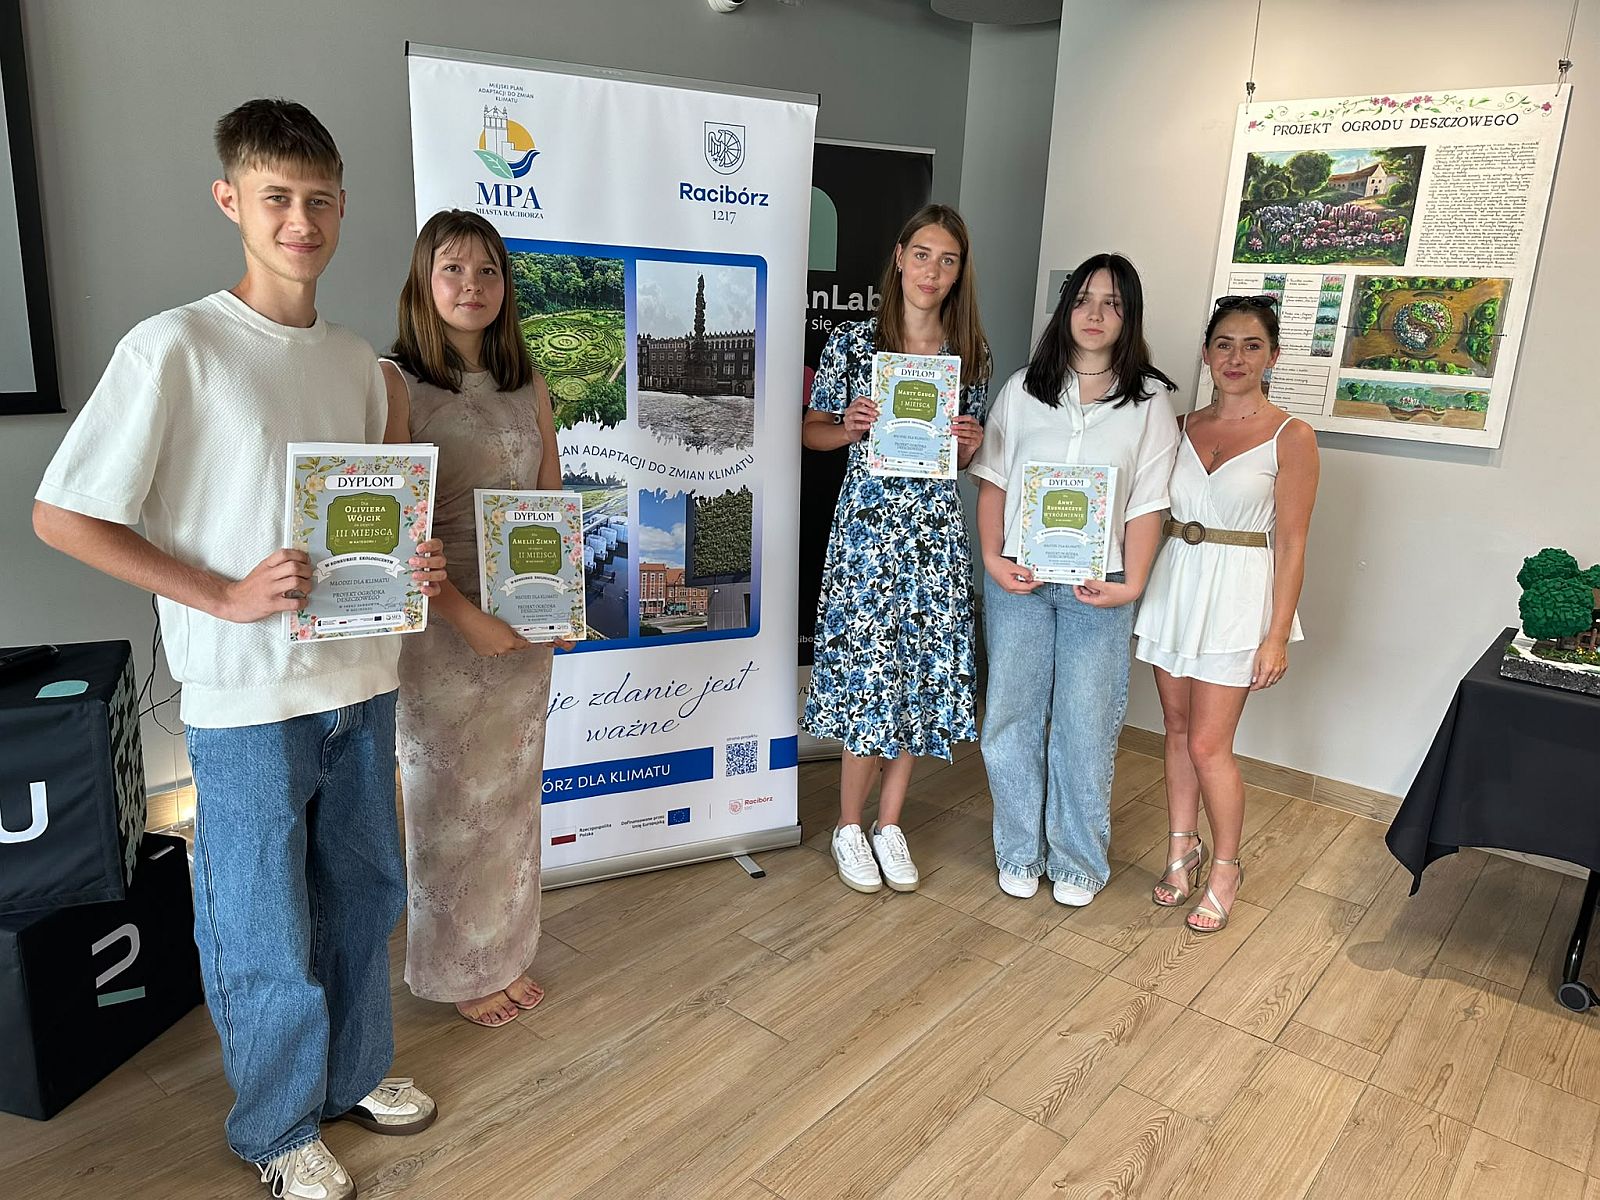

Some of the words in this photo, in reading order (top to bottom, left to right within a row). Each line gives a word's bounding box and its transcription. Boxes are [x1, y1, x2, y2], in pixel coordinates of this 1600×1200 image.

[478, 88, 507, 97] ADAPTACJI
[517, 92, 534, 100] ZMIAN
[1272, 122, 1332, 136] PROJEKT
[1341, 119, 1403, 132] OGRODU
[1410, 114, 1519, 129] DESZCZOWEGO
[475, 182, 543, 210] MPA
[680, 182, 769, 206] Racibórz
[476, 208, 502, 217] MIASTA
[713, 210, 736, 225] 1217
[806, 284, 882, 312] nLab
[812, 315, 832, 334] się
[901, 369, 935, 378] DYPLOM
[582, 445, 646, 470] ADAPTACJI
[648, 462, 666, 474] DO
[668, 467, 705, 481] ZMIAN
[708, 454, 754, 480] KLIMATU
[338, 477, 394, 488] DYPLOM
[347, 514, 381, 522] WÓJCIK
[514, 512, 554, 521] DYPLOM
[336, 530, 348, 538] III
[351, 528, 393, 537] MIEJSCA
[588, 672, 692, 706] zdanie
[678, 660, 760, 719] jest
[586, 717, 681, 742] ważne
[578, 774, 607, 789] DLA
[610, 764, 671, 784] KLIMATU
